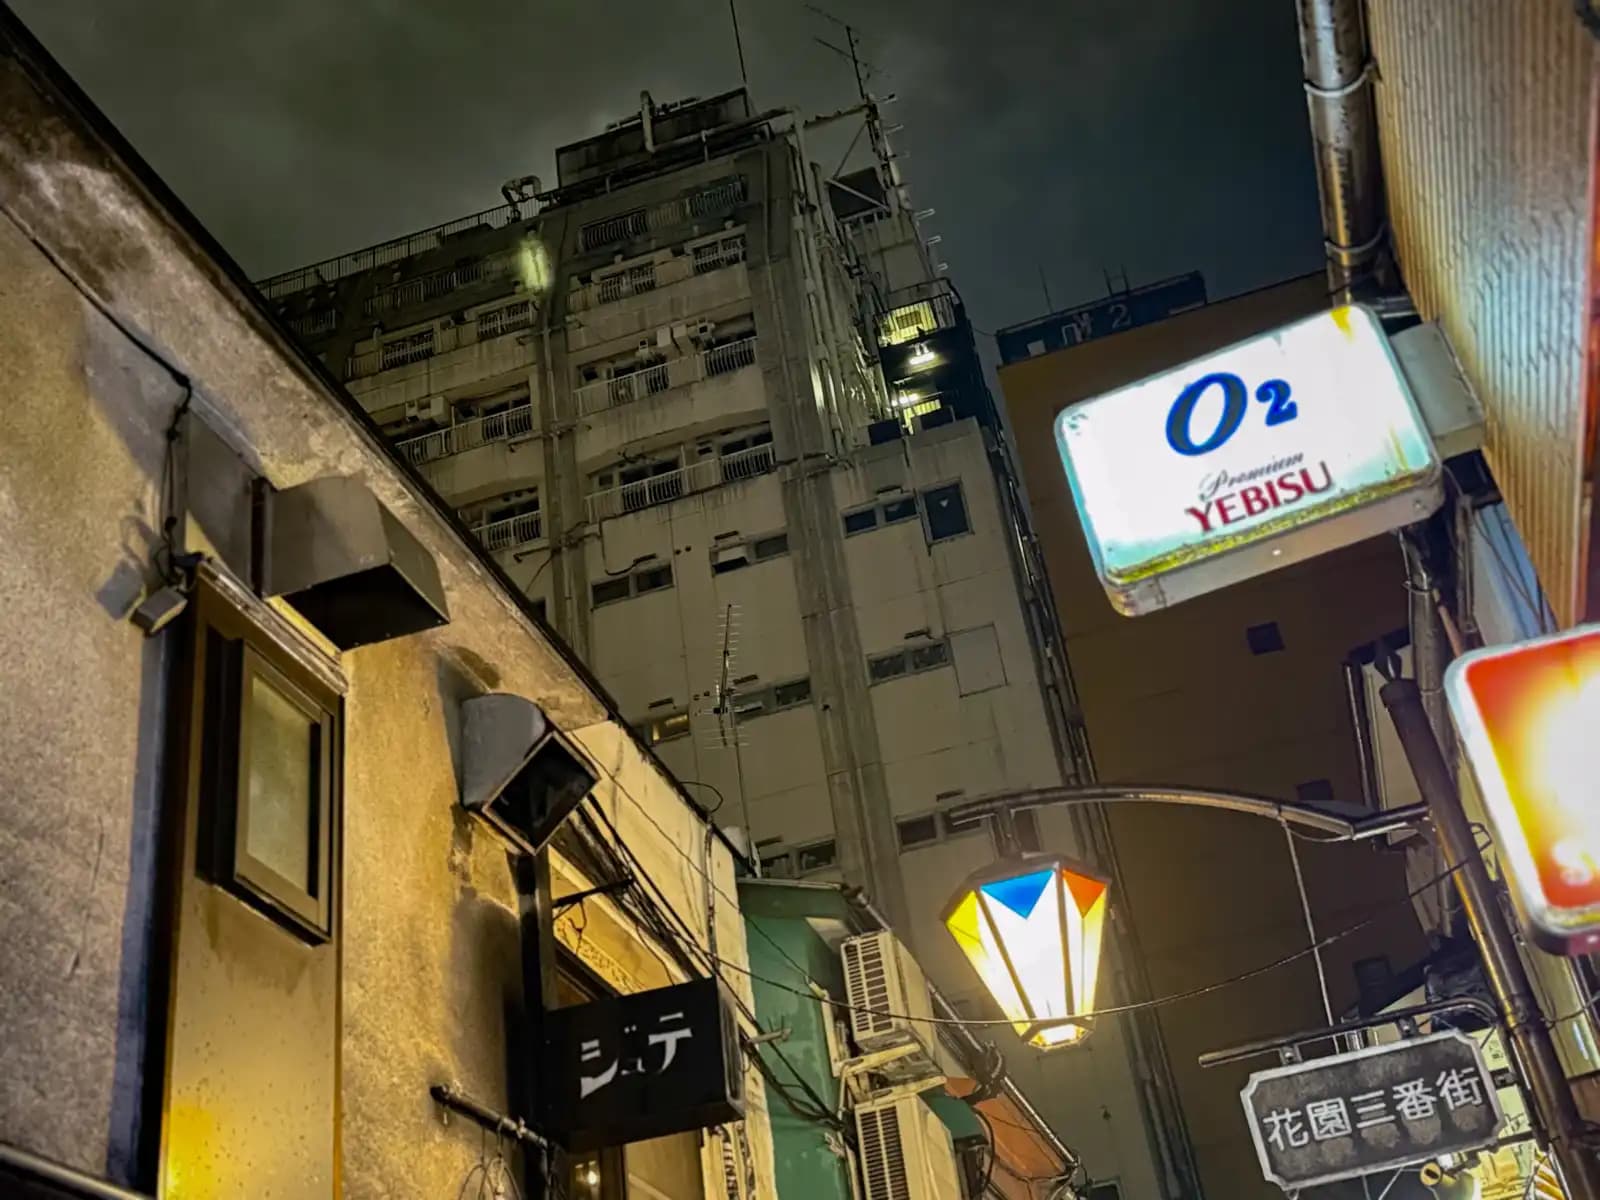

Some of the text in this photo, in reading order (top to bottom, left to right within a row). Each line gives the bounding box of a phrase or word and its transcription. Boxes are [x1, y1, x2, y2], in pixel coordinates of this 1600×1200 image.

[1184, 461, 1333, 532] YEBISU
[1199, 452, 1304, 500] Premium
[1262, 1066, 1484, 1151] 花園三番街
